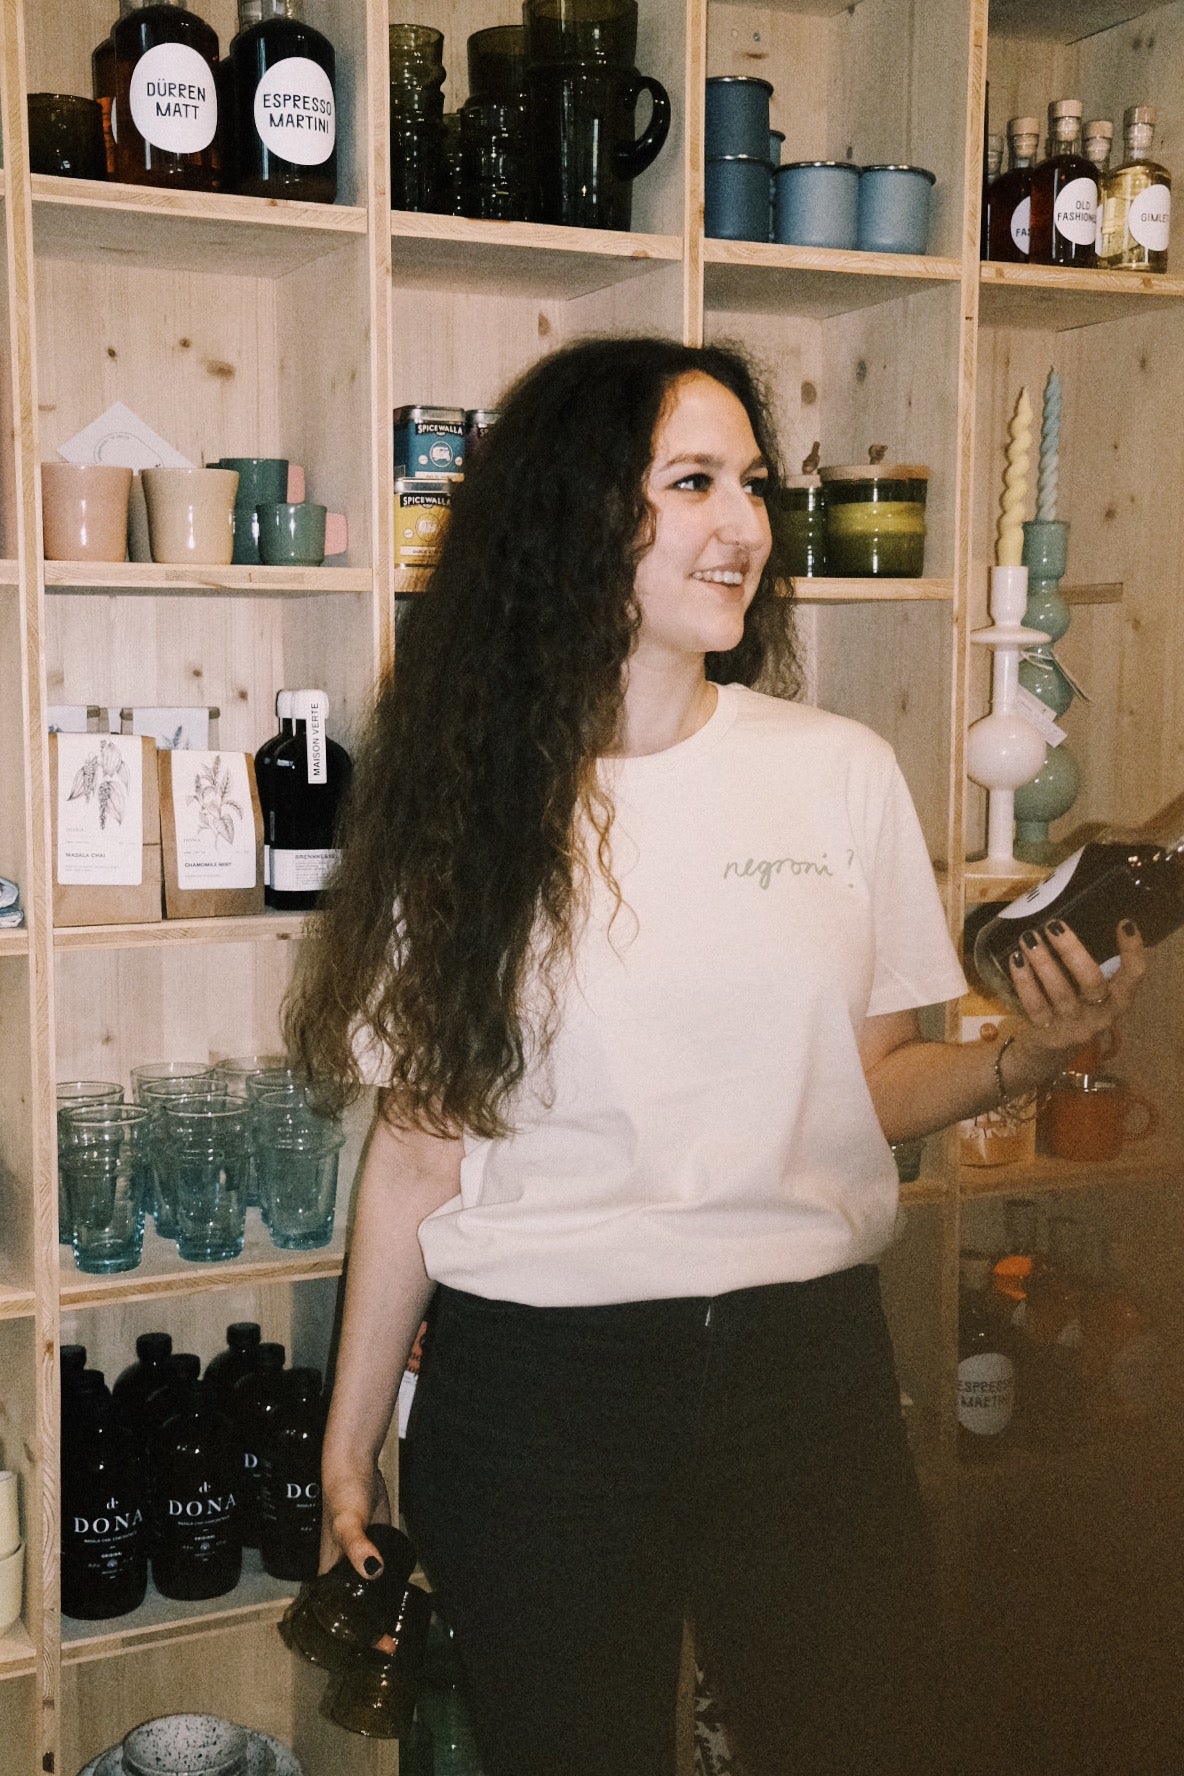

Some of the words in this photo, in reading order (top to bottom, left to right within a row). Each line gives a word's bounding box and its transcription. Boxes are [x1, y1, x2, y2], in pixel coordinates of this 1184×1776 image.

[146, 78, 206, 102] DÜRREN
[155, 102, 199, 120] MATT
[263, 93, 332, 116] ESPRESSO
[269, 113, 329, 134] MARTINI
[1075, 200, 1091, 211] OLD
[417, 423, 463, 436] SPICEWALLA
[311, 703, 320, 736] VERTE
[312, 738, 321, 776] MAISON
[723, 852, 834, 891] negroni
[169, 1493, 237, 1517] DONA
[73, 1508, 143, 1534] DONA
